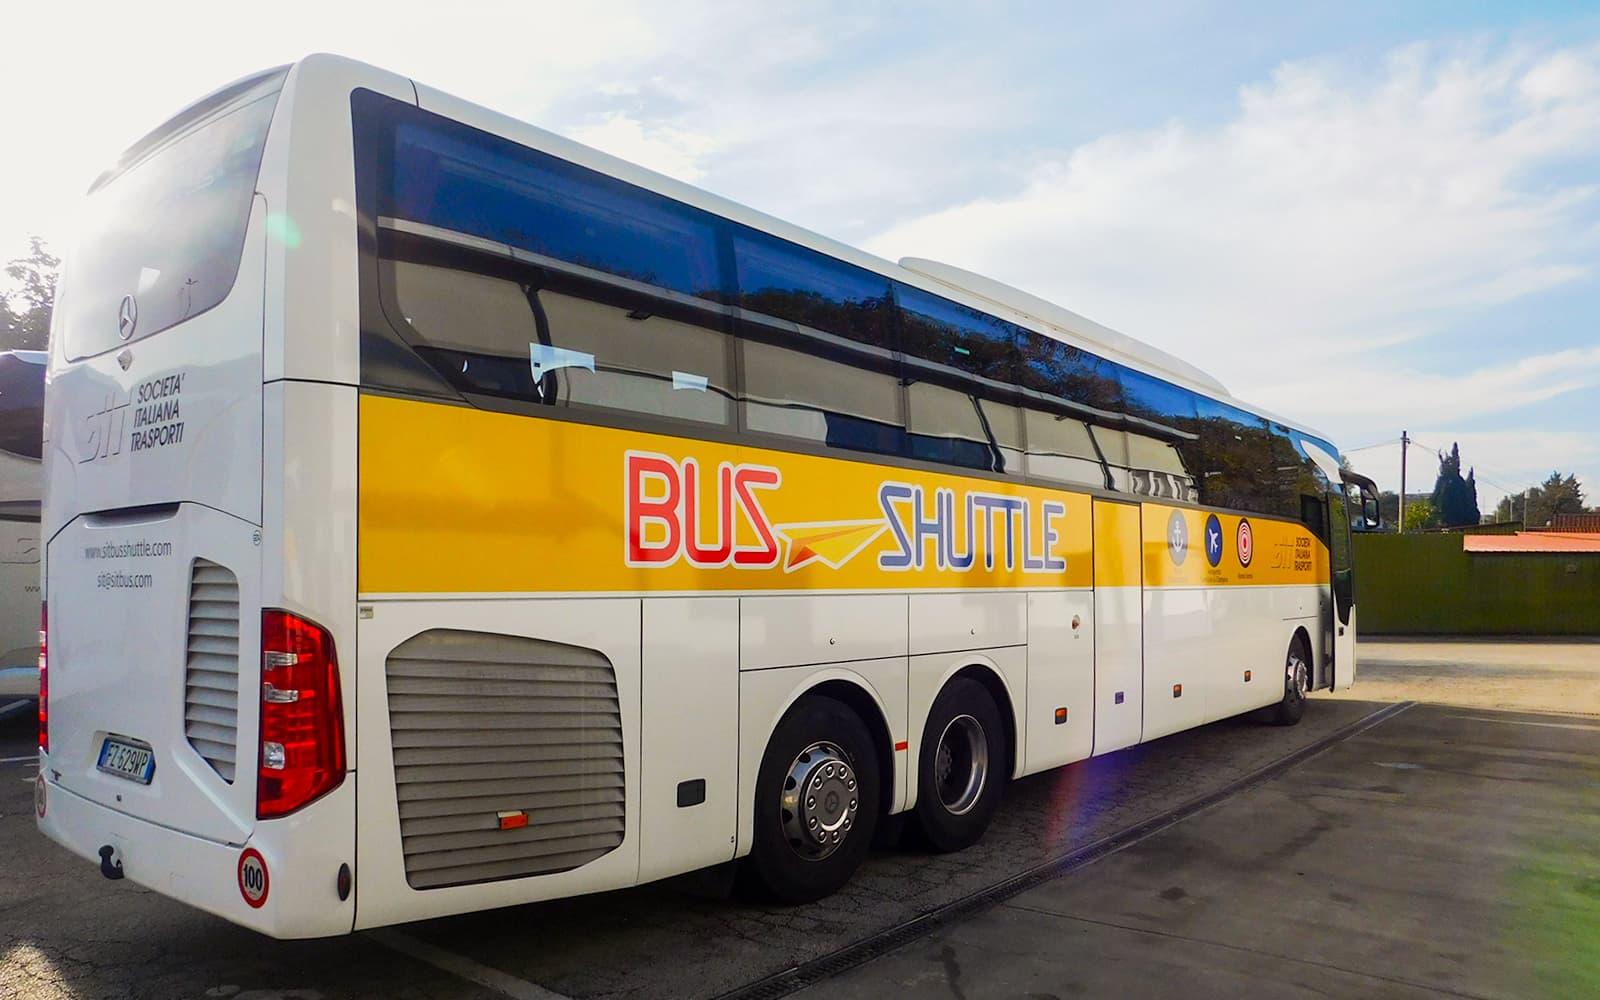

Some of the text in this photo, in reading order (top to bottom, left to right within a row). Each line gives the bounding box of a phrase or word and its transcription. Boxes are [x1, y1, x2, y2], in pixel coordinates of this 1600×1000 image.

[133, 398, 180, 428] ITALIANA
[130, 422, 185, 452] TRASPORTI
[624, 450, 1067, 574] BUS SHUTTLE
[97, 570, 153, 590] sit@sitbus.com
[243, 863, 263, 891] 100
